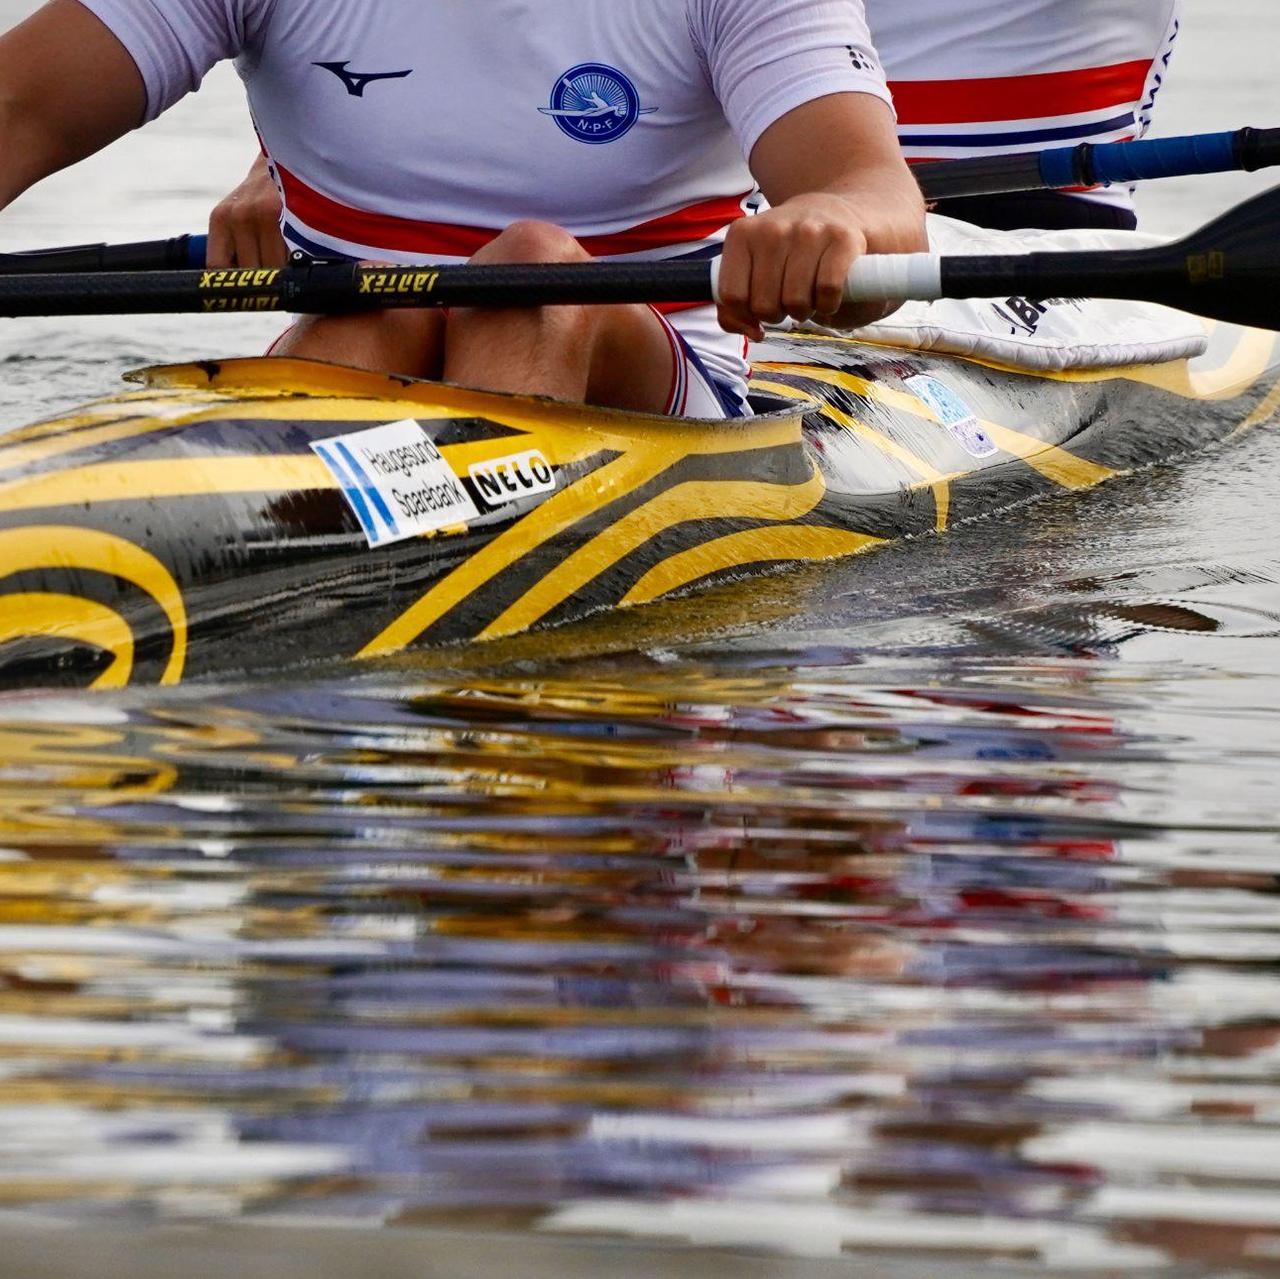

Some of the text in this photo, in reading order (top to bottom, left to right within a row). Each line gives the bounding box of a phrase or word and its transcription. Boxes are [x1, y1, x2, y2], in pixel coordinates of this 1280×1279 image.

[199, 269, 280, 288] JANTEX
[358, 271, 440, 294] JANTEX
[366, 439, 443, 477] Haugesund
[473, 456, 551, 497] NELO
[392, 475, 467, 524] Sparebank
